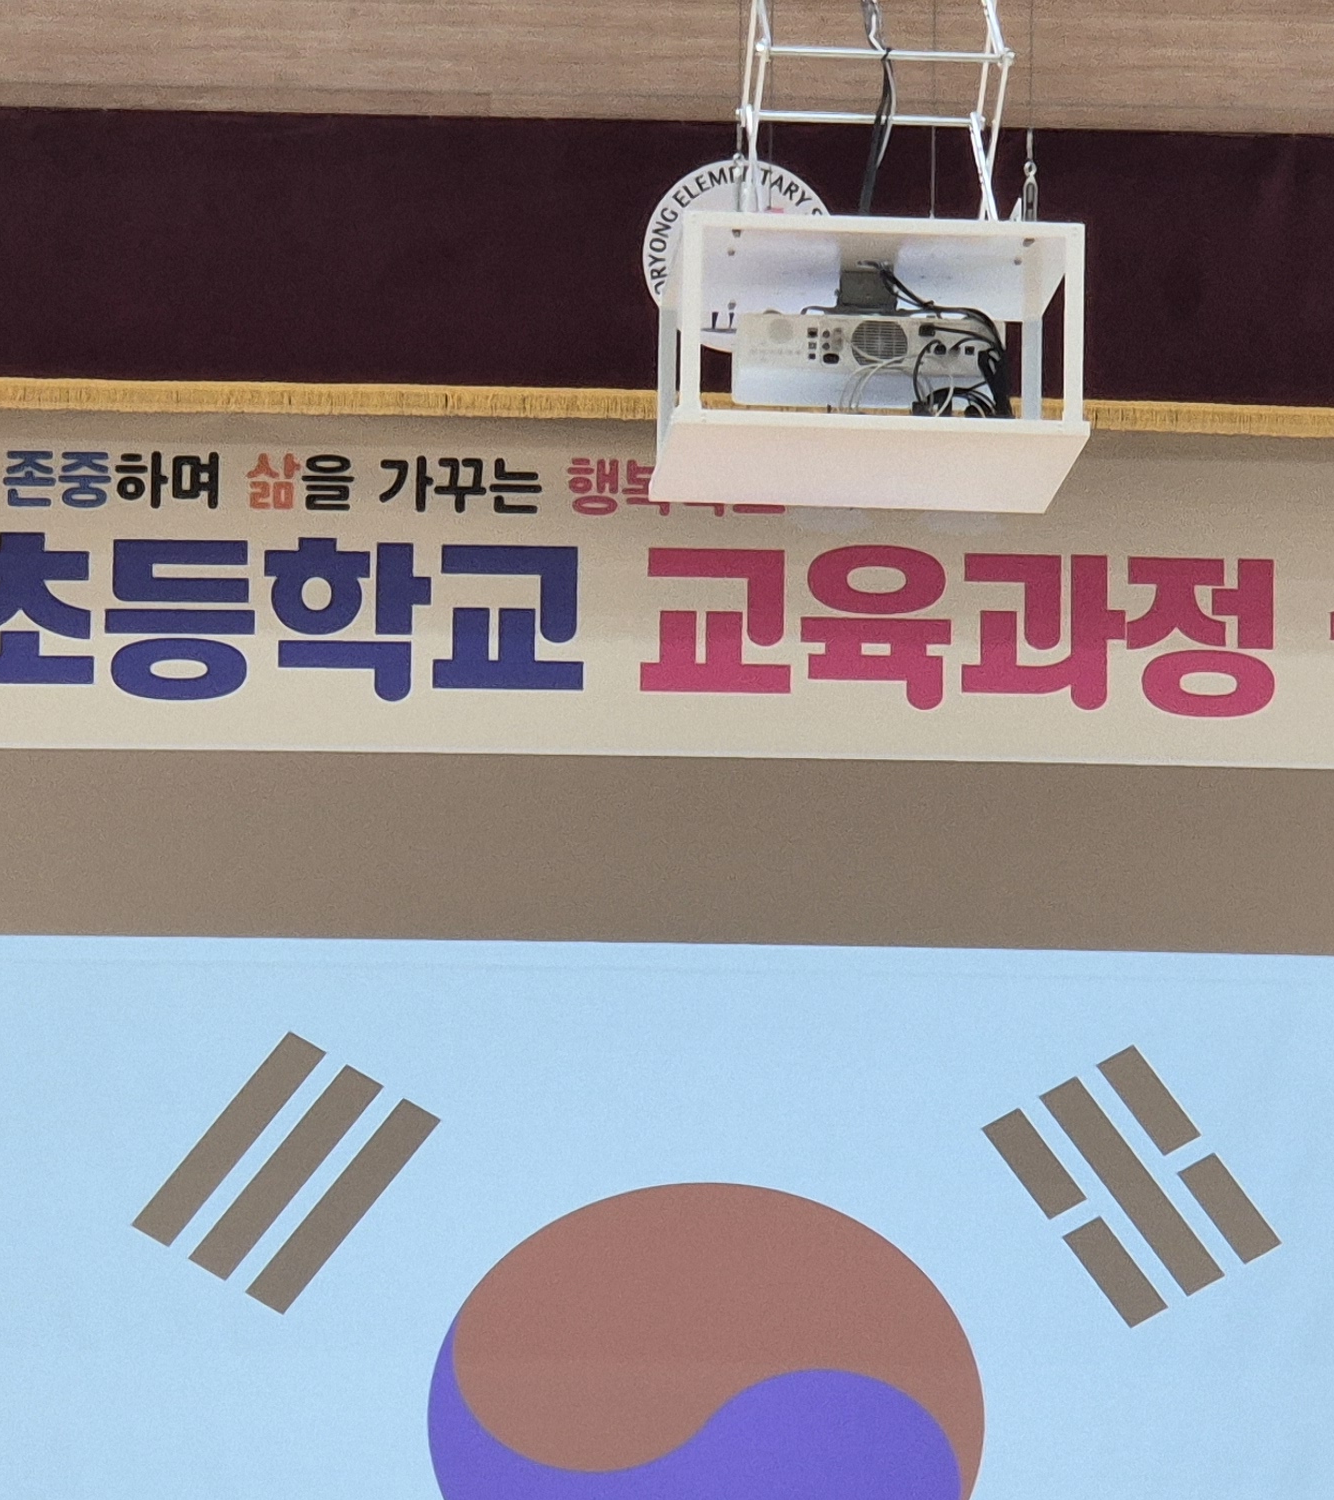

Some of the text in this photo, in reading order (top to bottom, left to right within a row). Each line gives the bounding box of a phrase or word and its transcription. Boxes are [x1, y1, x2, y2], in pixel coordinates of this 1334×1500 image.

[2, 449, 220, 510] 존중하며
[244, 455, 355, 512] 삶을
[379, 456, 543, 514] 가꾸는
[640, 543, 1275, 717] 교육과정
